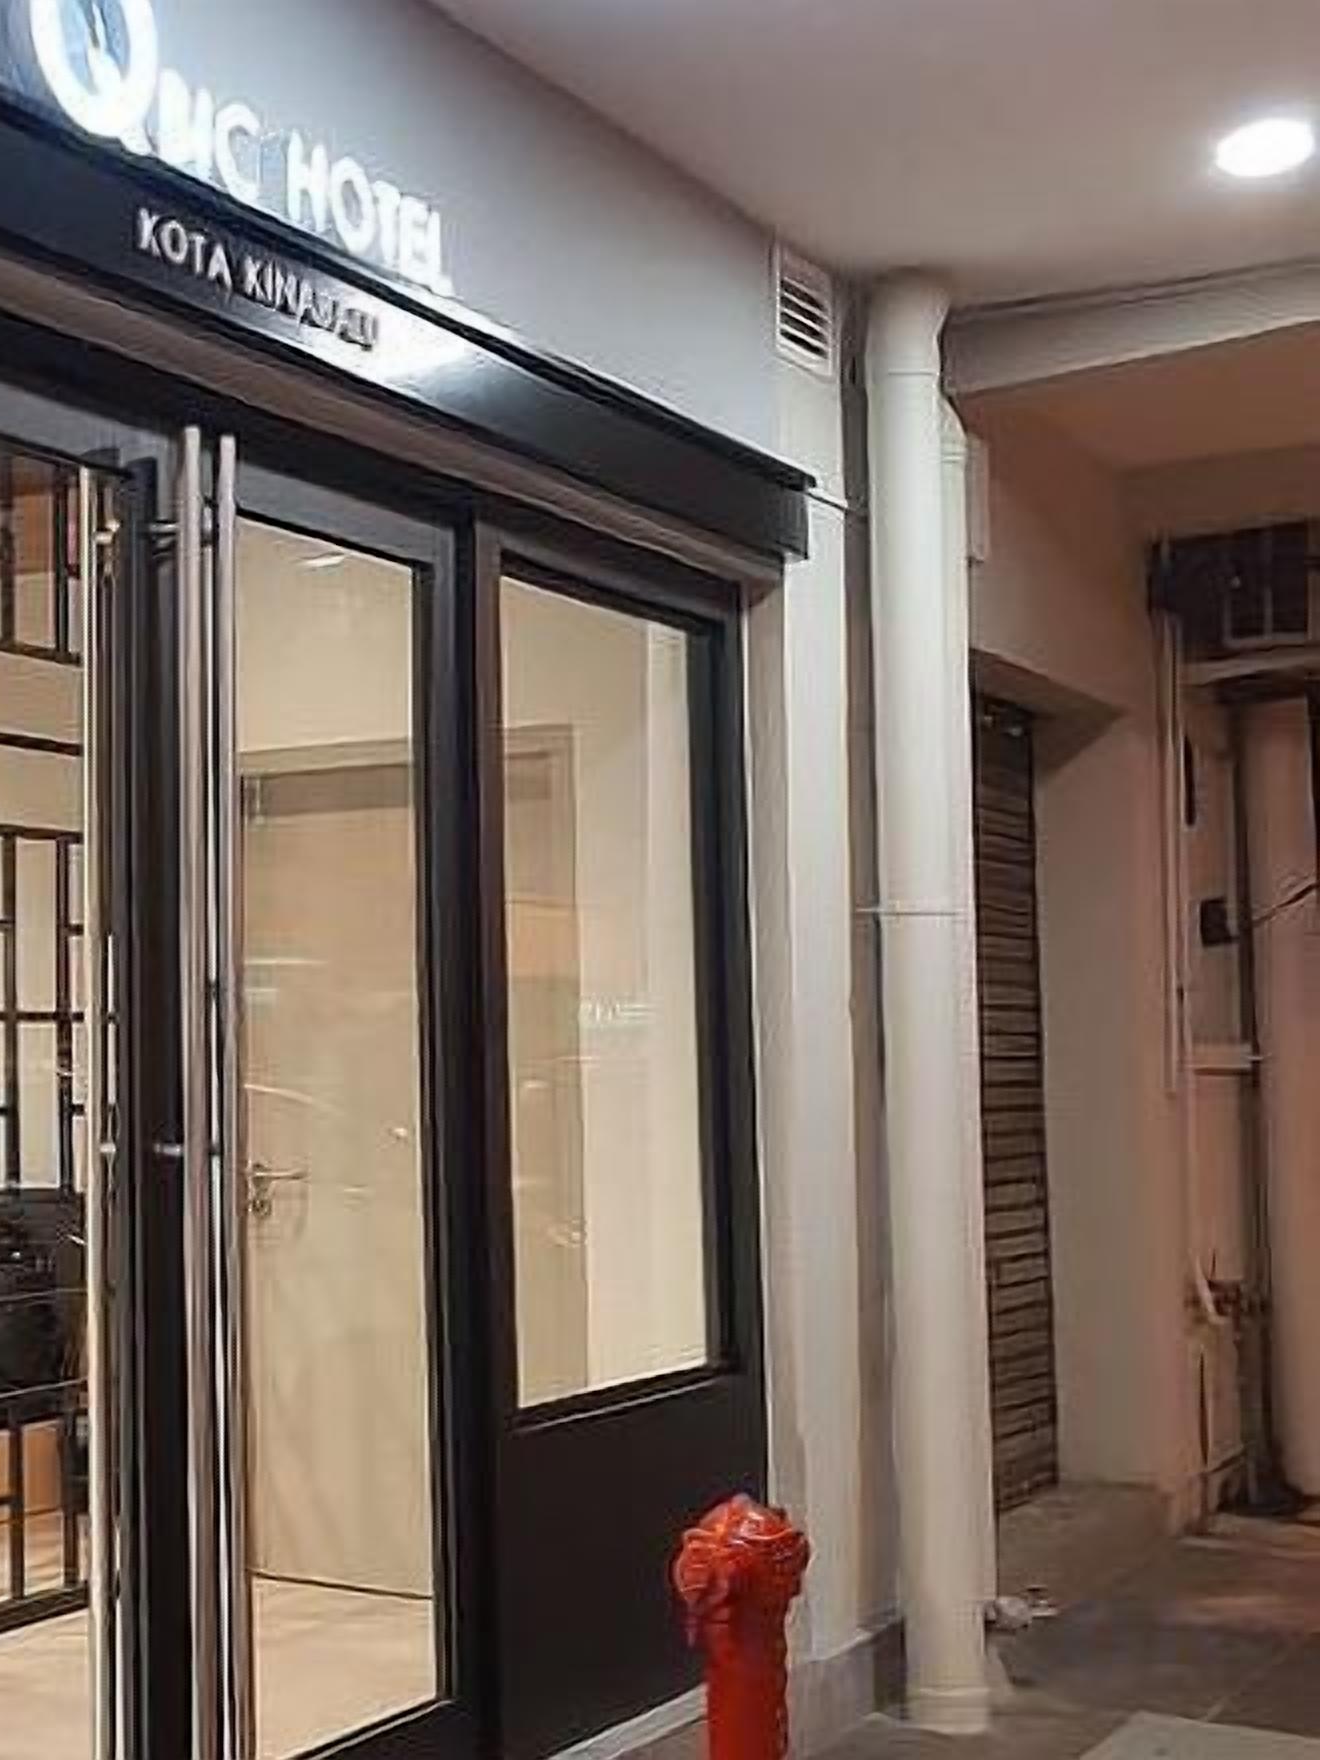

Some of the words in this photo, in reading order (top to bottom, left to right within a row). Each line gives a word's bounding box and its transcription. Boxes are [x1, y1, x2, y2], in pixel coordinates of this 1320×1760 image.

[135, 207, 232, 292] KOTA
[242, 255, 379, 351] KINAA
[286, 128, 456, 298] HOTEL
